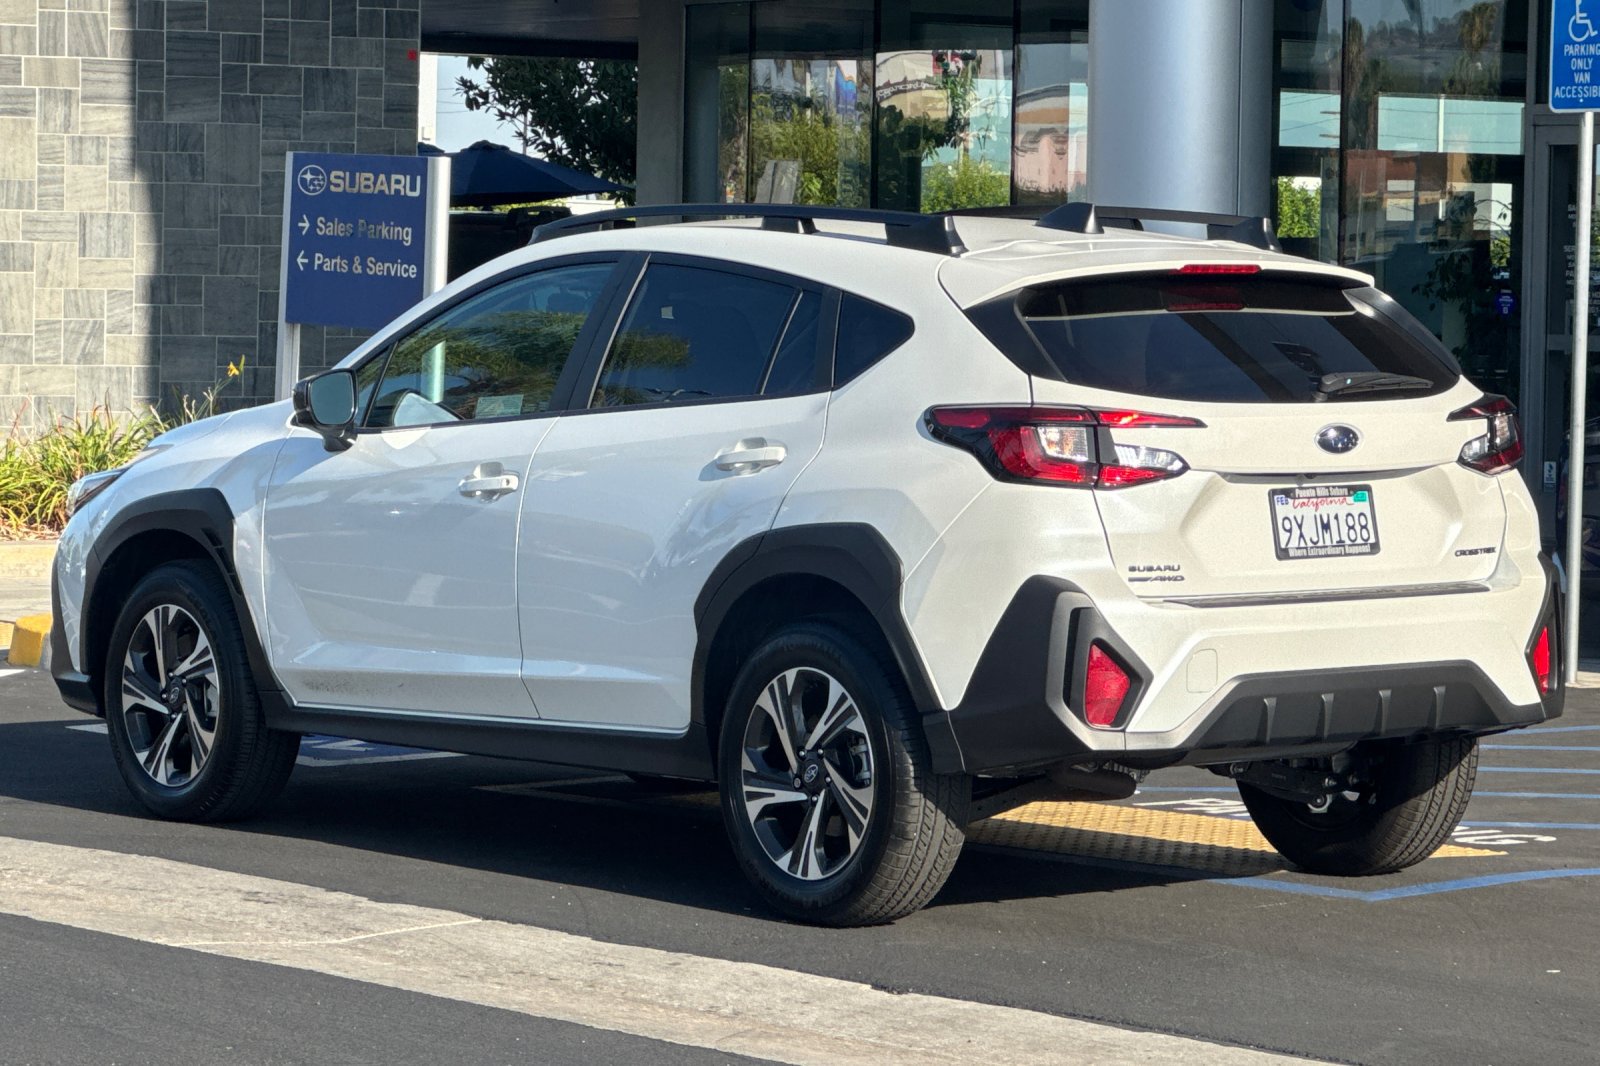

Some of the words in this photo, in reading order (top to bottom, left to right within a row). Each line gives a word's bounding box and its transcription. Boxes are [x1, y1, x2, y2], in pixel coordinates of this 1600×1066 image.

[1564, 43, 1600, 56] PARKING
[1571, 58, 1593, 71] ONLY
[1574, 72, 1590, 84] VAN
[329, 170, 421, 197] SUBARU
[316, 216, 353, 237] Sales
[358, 219, 412, 247] Parking
[314, 252, 348, 273] Parts
[352, 255, 362, 275] &
[366, 256, 417, 279] Service
[1292, 496, 1353, 512] California
[1282, 512, 1371, 548] 9XJM188
[1128, 564, 1180, 572] SUBARU
